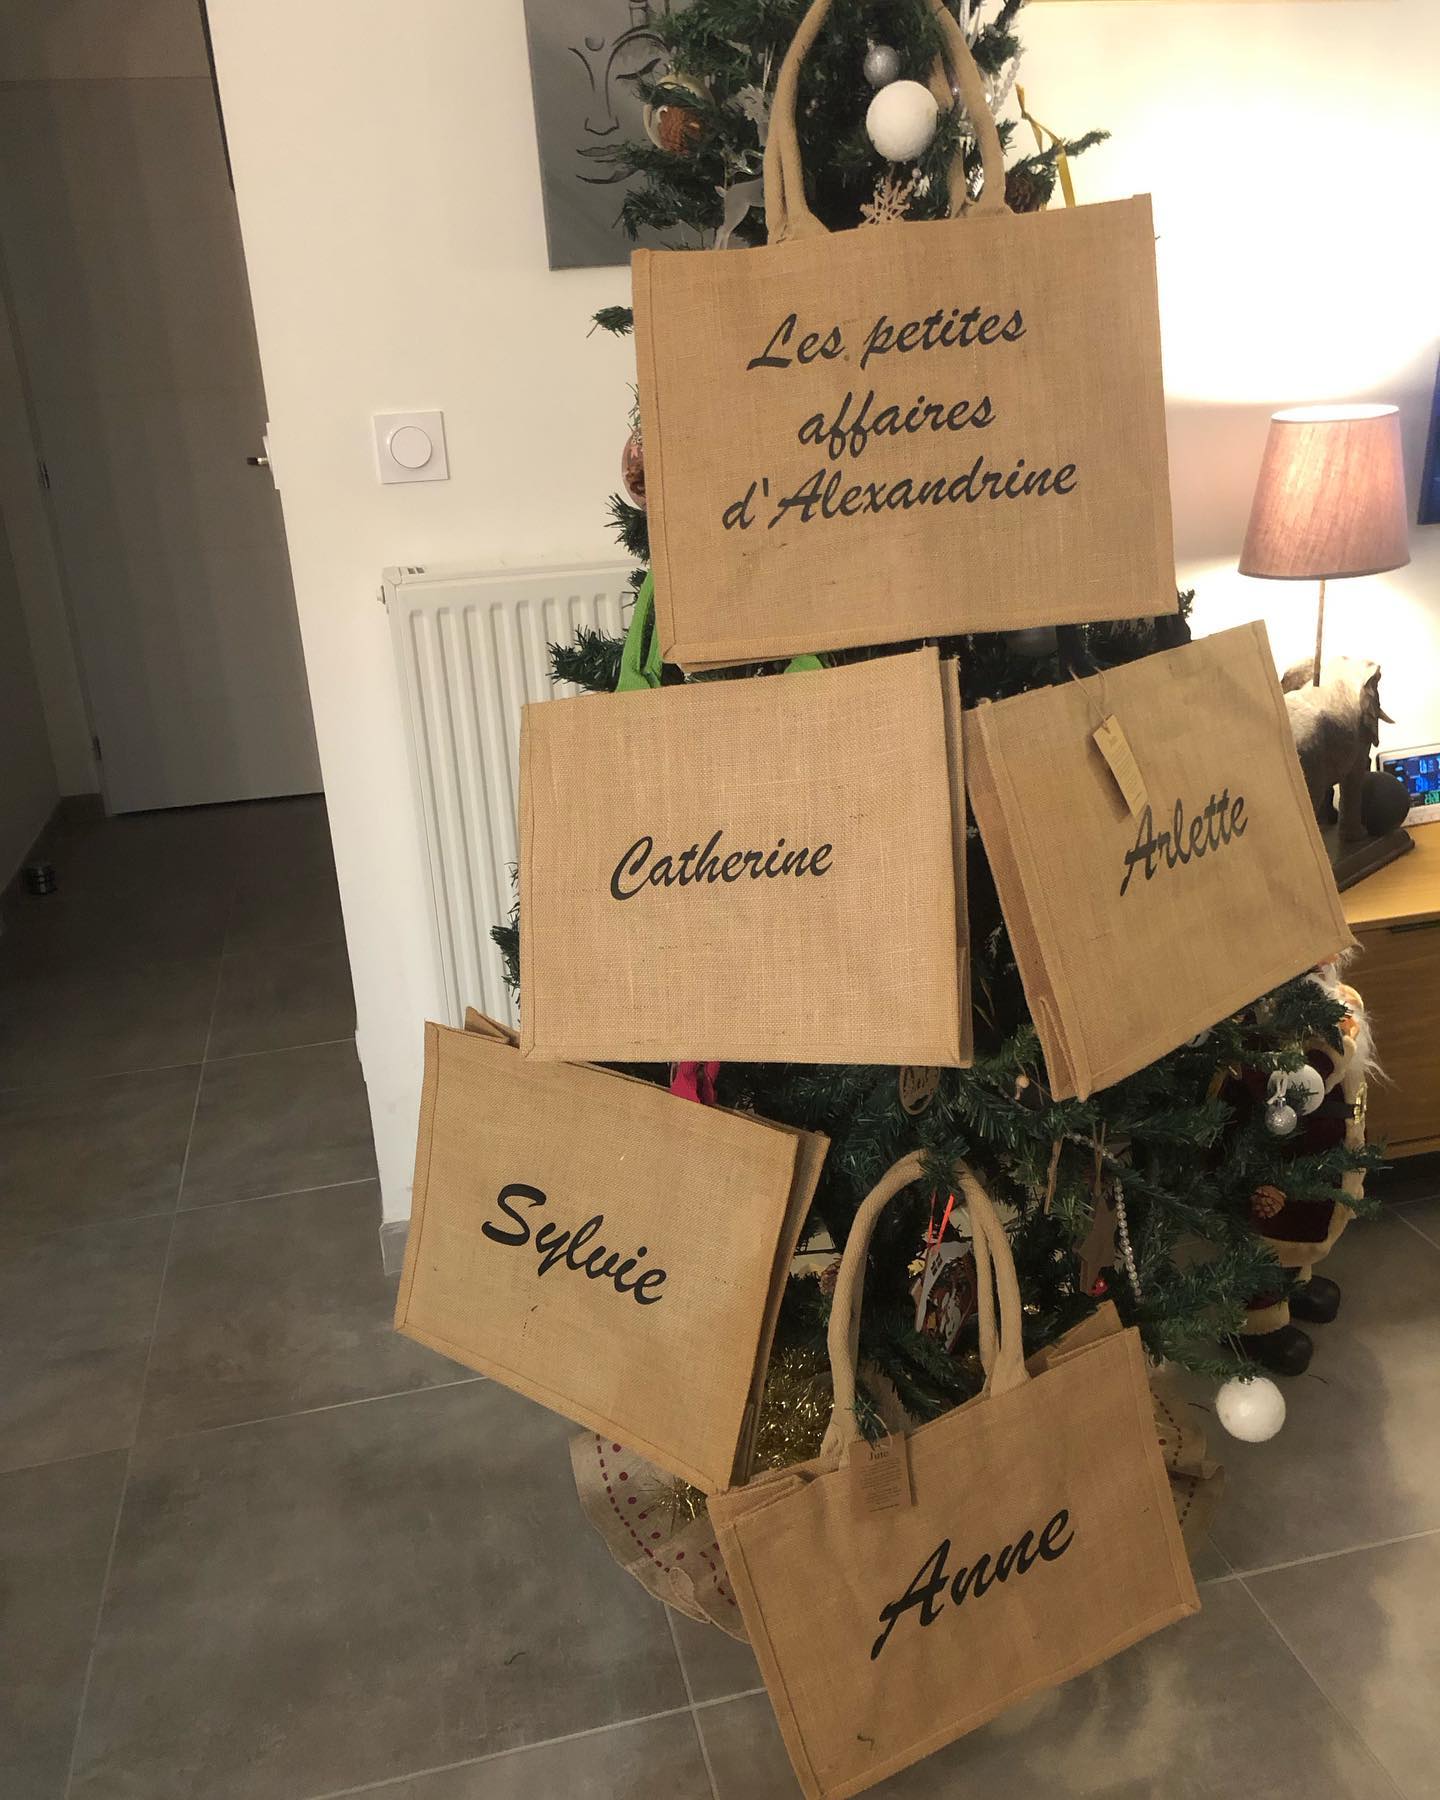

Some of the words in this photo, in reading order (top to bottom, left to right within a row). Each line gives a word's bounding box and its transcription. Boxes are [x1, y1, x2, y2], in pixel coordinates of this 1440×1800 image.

[746, 313, 845, 371] Les
[859, 306, 1027, 370] petites
[797, 390, 996, 459] affaires
[721, 456, 1077, 530] d'Alexandrine
[610, 829, 833, 900] Catherine
[1120, 788, 1248, 896] Arlette
[481, 1183, 667, 1306] Sylvie
[870, 1508, 1075, 1661] Anne
